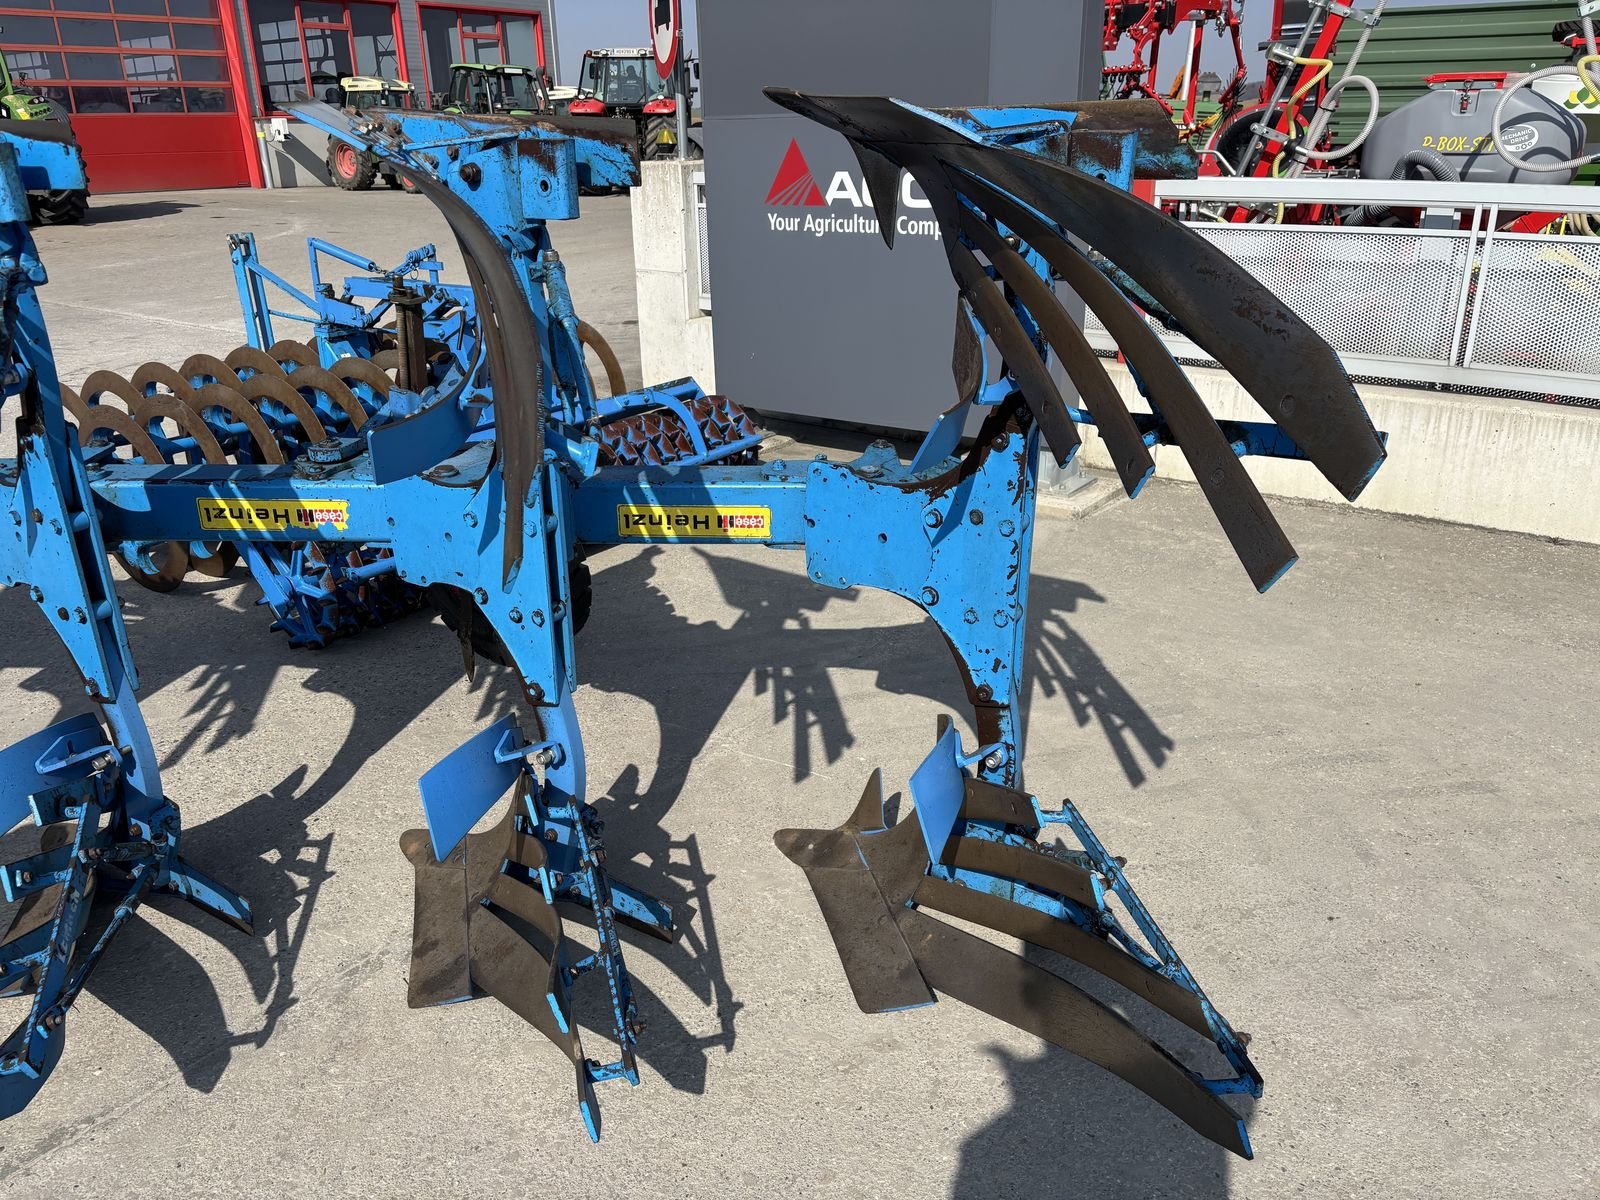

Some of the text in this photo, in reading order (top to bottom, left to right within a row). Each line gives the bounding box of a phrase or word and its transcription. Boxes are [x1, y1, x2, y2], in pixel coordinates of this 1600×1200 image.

[768, 213, 800, 231] Your
[804, 213, 880, 237] Agricultur
[204, 507, 290, 524] Heinzl
[623, 514, 709, 530] Heinzl
